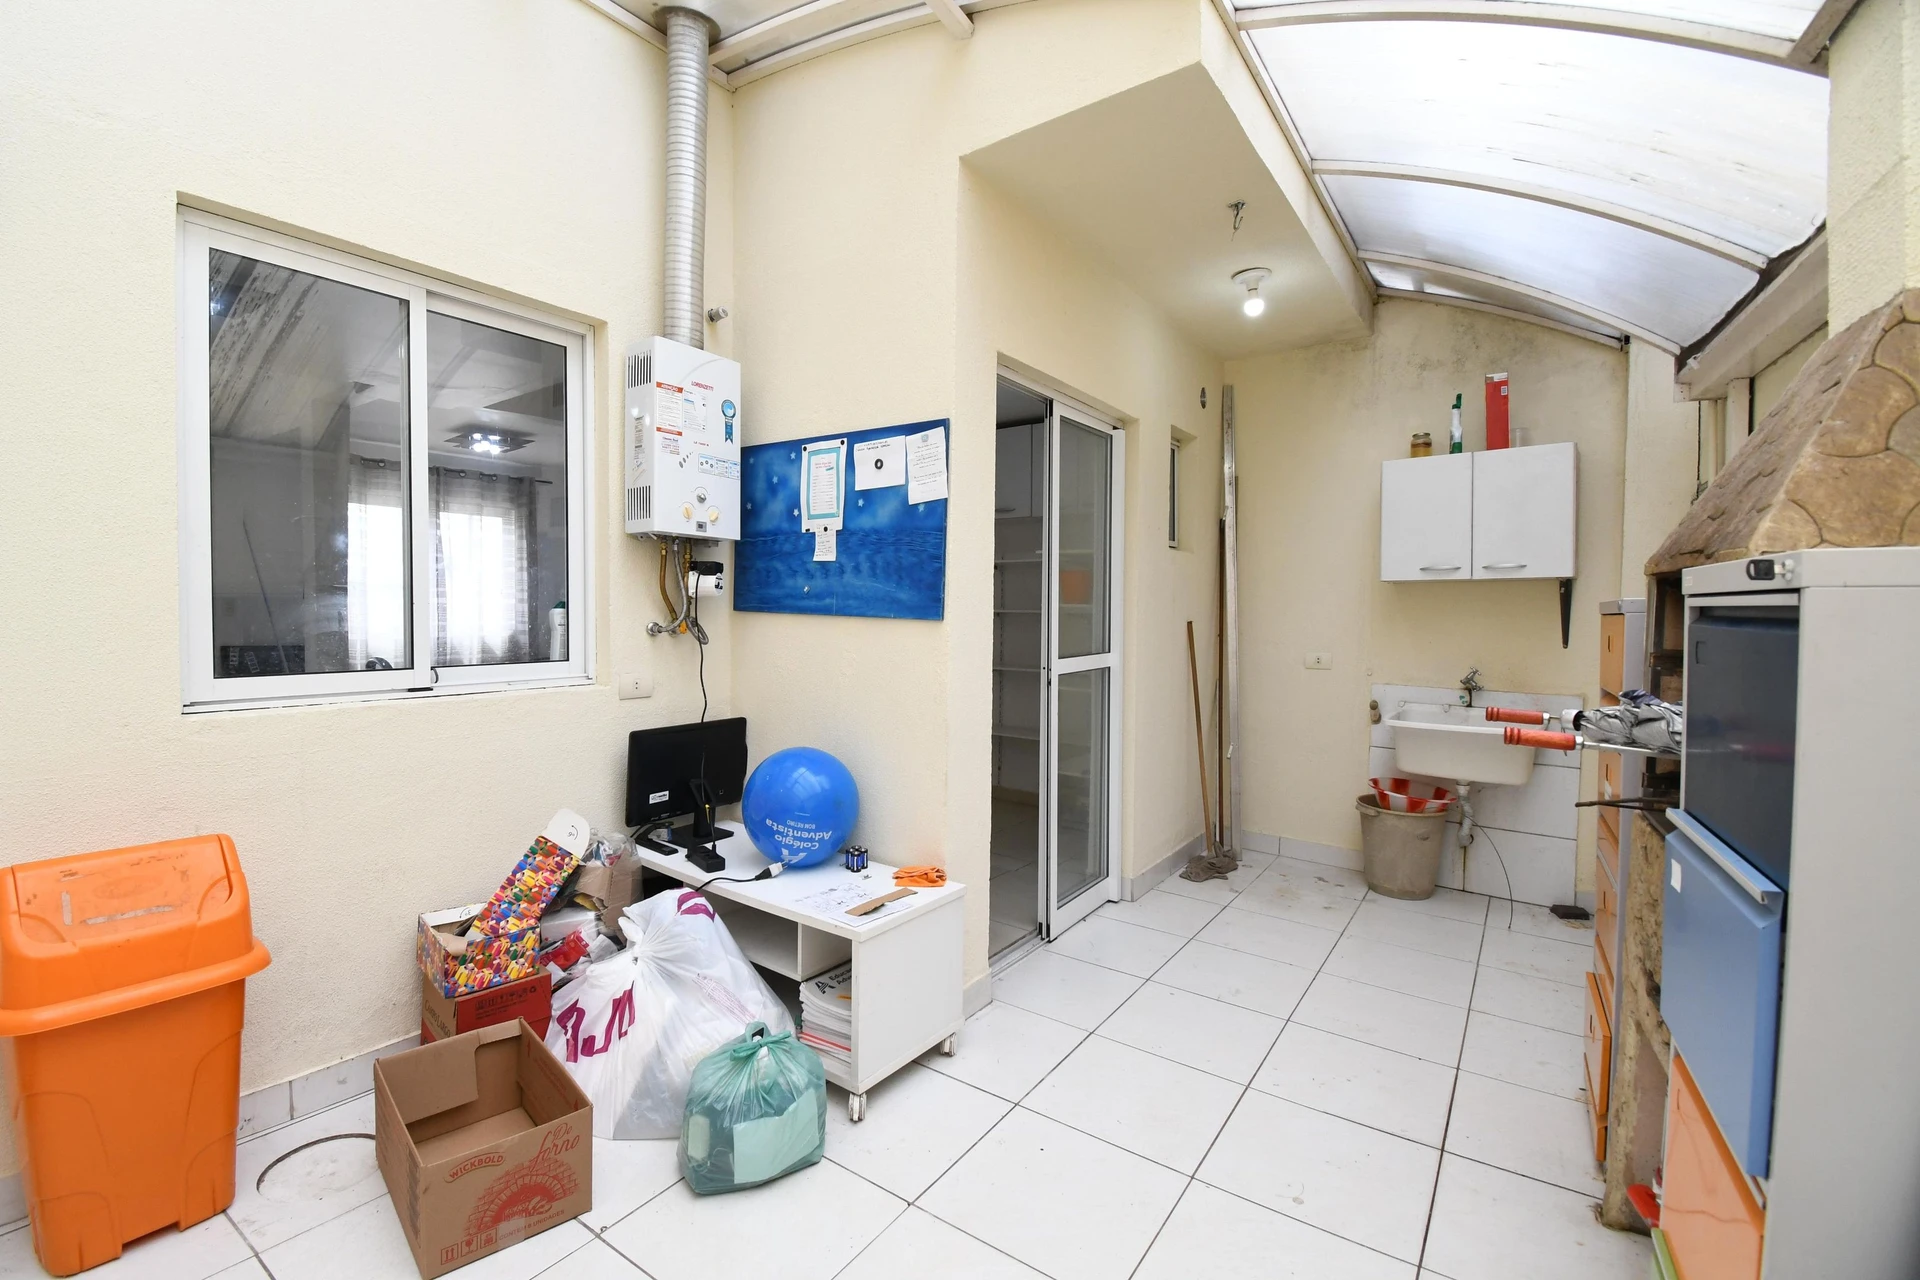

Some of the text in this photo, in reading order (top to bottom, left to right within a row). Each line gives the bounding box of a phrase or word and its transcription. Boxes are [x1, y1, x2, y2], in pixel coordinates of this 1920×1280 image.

[691, 381, 714, 392] LORENZETTI
[765, 818, 832, 841] Adventista
[774, 834, 819, 850] Colégio
[529, 1130, 580, 1173] forno
[449, 1154, 504, 1179] WICKBOLD
[532, 1209, 565, 1227] UNIDADES
